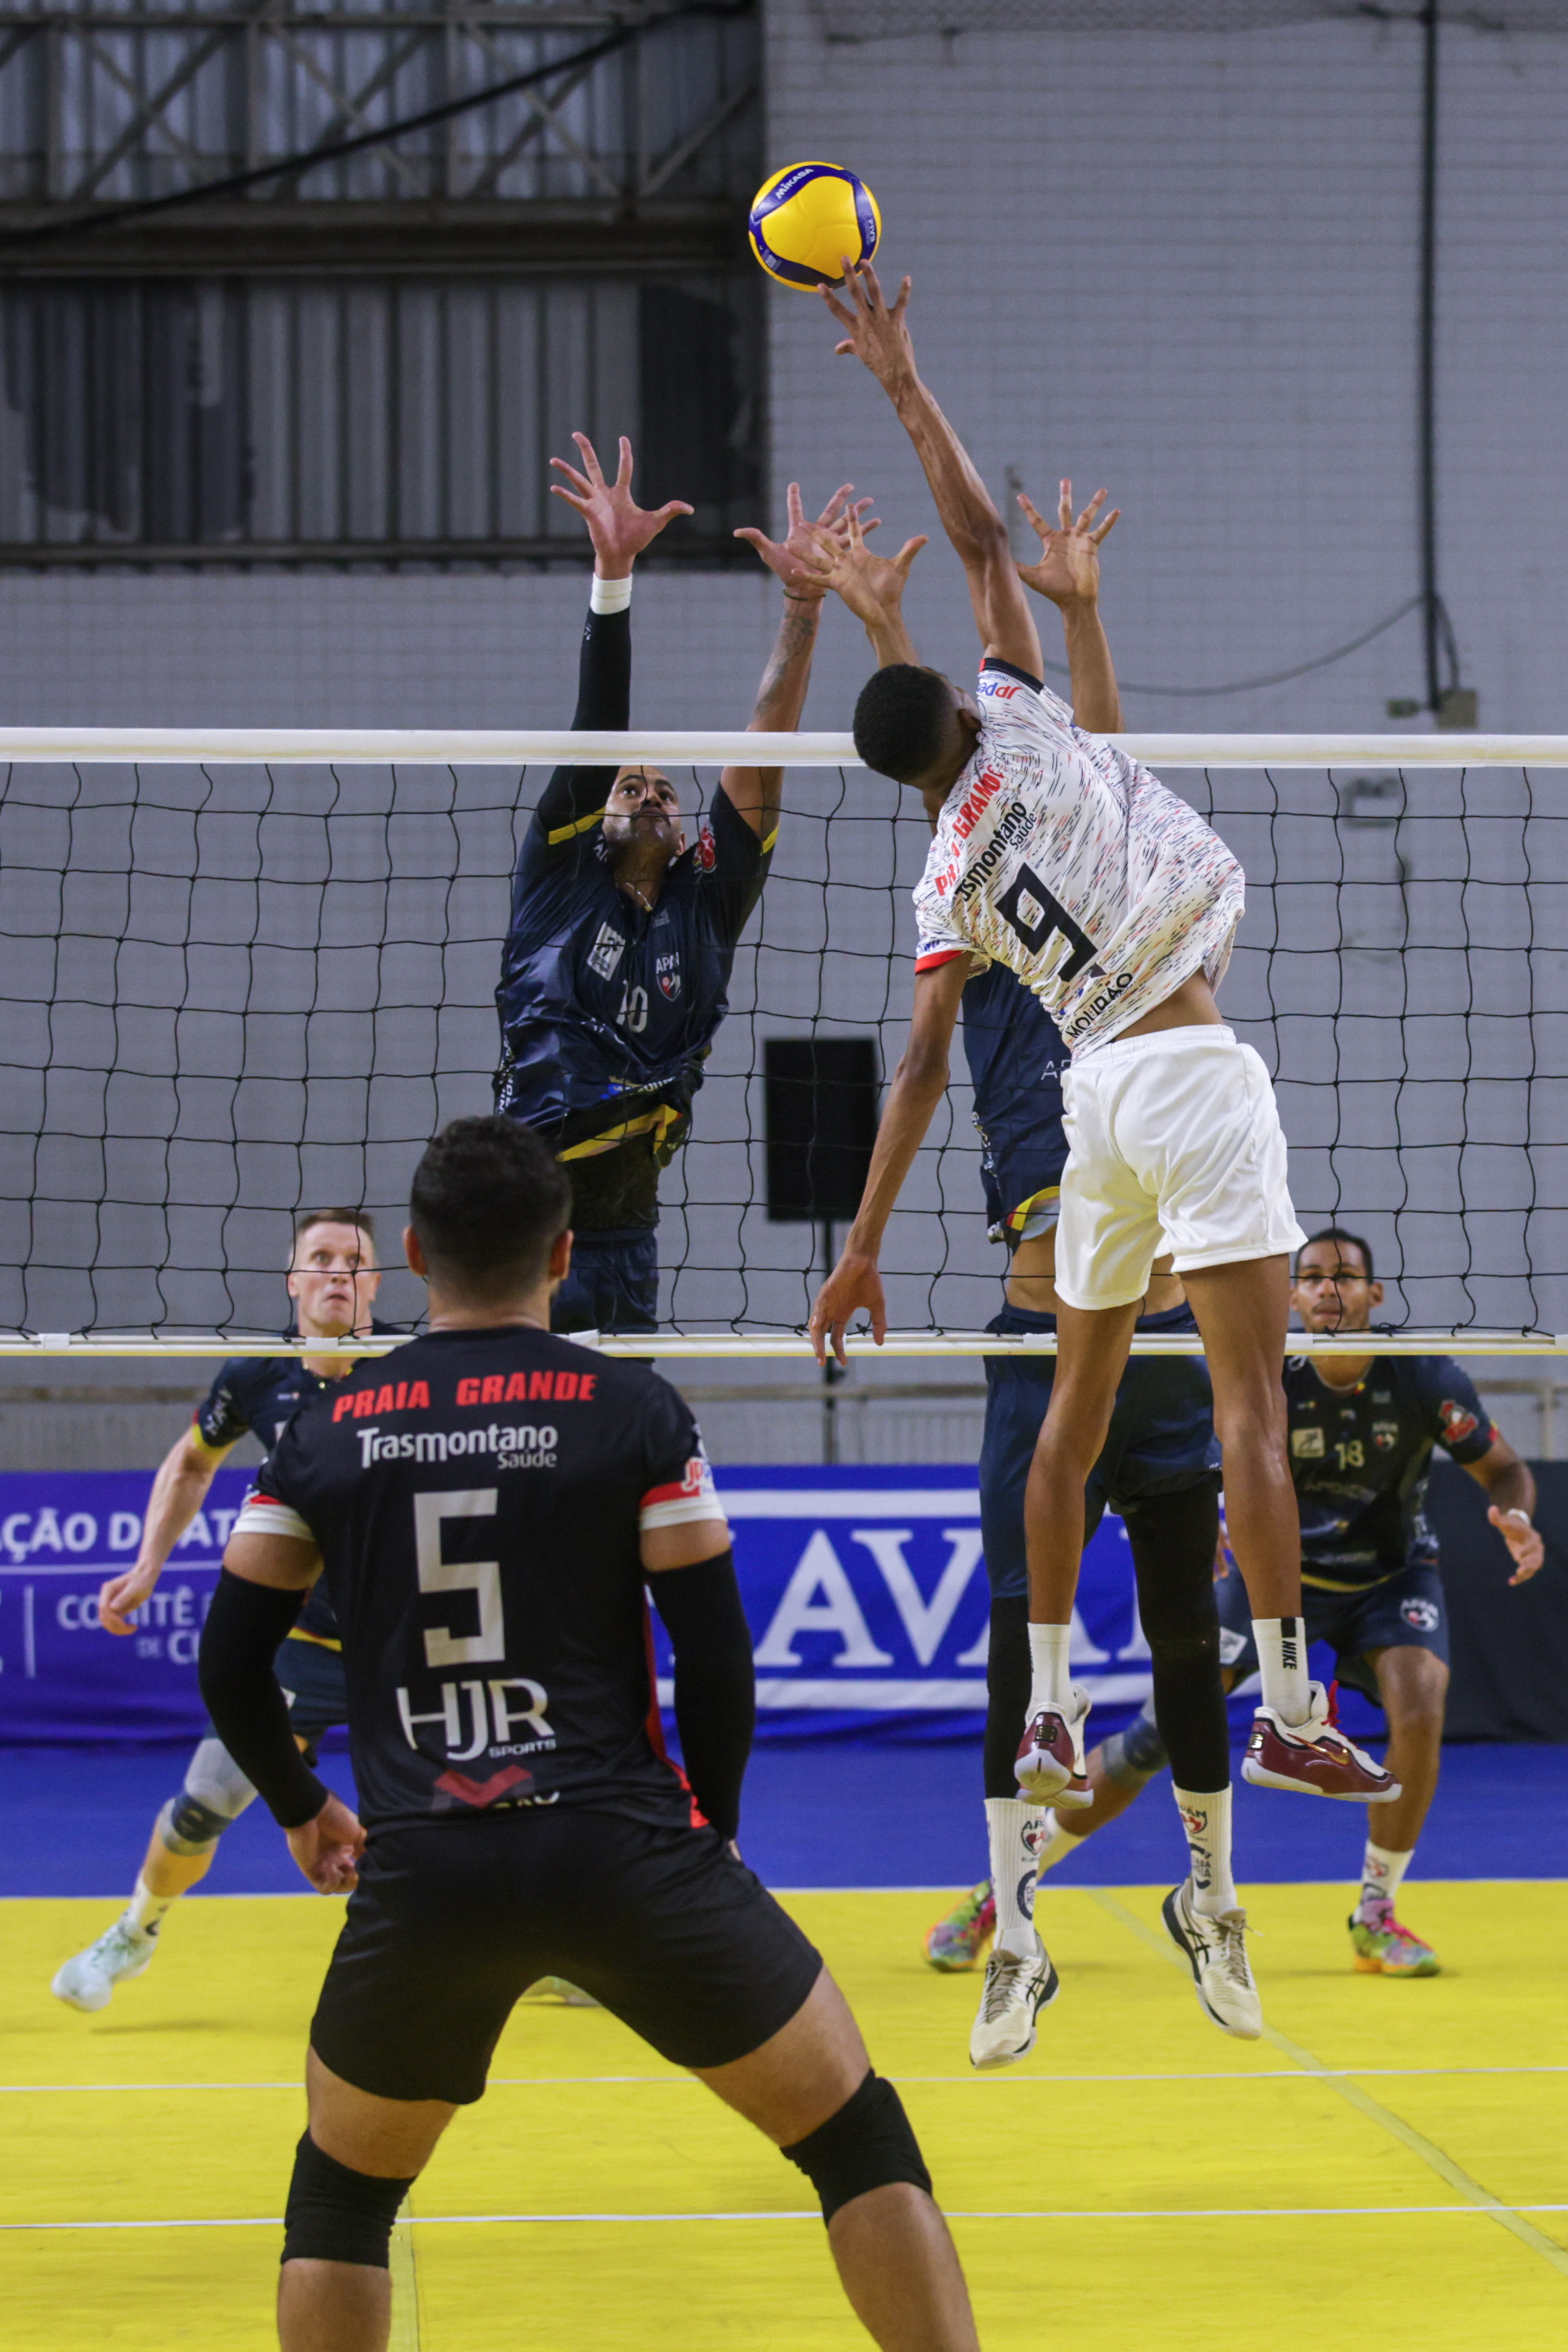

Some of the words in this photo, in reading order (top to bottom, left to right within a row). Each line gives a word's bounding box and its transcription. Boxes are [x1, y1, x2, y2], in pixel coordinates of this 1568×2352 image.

[995, 862, 1098, 983] 9
[616, 979, 648, 1033] 10
[332, 1381, 430, 1423] PRAIA
[456, 1370, 597, 1406] GRANDE
[357, 1424, 558, 1468] Trasmontano
[497, 1448, 557, 1470] Saúde
[1334, 1439, 1365, 1471] 18
[0, 1507, 98, 1563] ÇÃO
[413, 1488, 506, 1668] 5
[1282, 1640, 1297, 1670] NIKE
[396, 1678, 555, 1761] HJR
[488, 1738, 557, 1758] SPORTS
